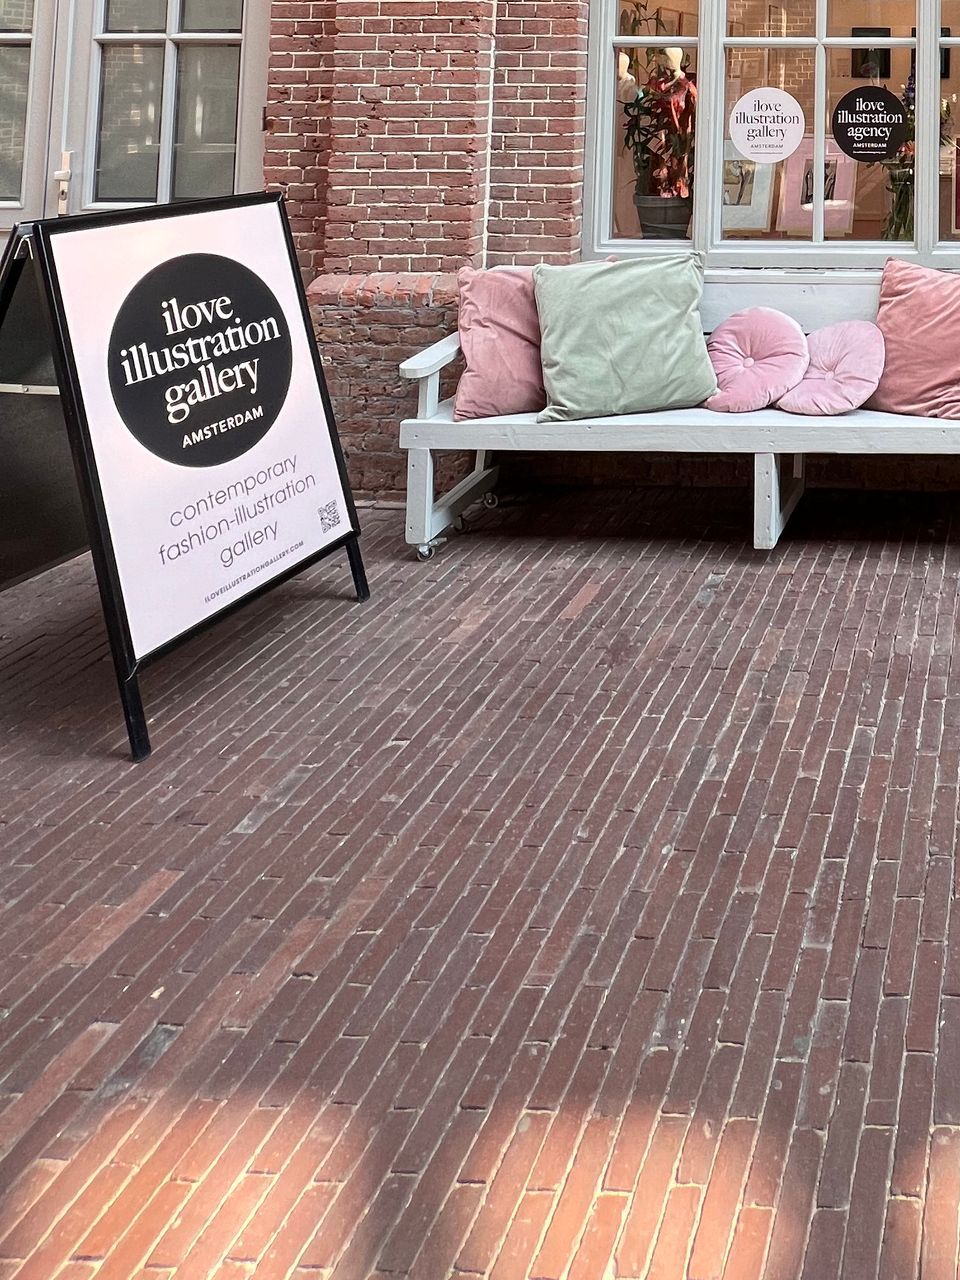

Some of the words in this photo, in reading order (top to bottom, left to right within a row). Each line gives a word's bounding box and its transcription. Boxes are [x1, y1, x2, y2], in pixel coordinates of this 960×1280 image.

[735, 111, 800, 124] illustration
[753, 99, 782, 112] ilove
[837, 110, 903, 124] illustration
[855, 98, 885, 111] ilove
[747, 125, 787, 141] gallery
[847, 126, 892, 141] agency
[161, 296, 234, 336] ilove
[120, 316, 282, 386] illustration
[164, 358, 260, 424] gallery
[182, 405, 264, 448] AMSTERDAM
[169, 455, 297, 527] contemporary
[158, 473, 316, 565] fashion-illustration
[220, 520, 279, 568] gallery
[203, 540, 305, 604] ILOVEILLUSTRATIONGALLERY.COM
